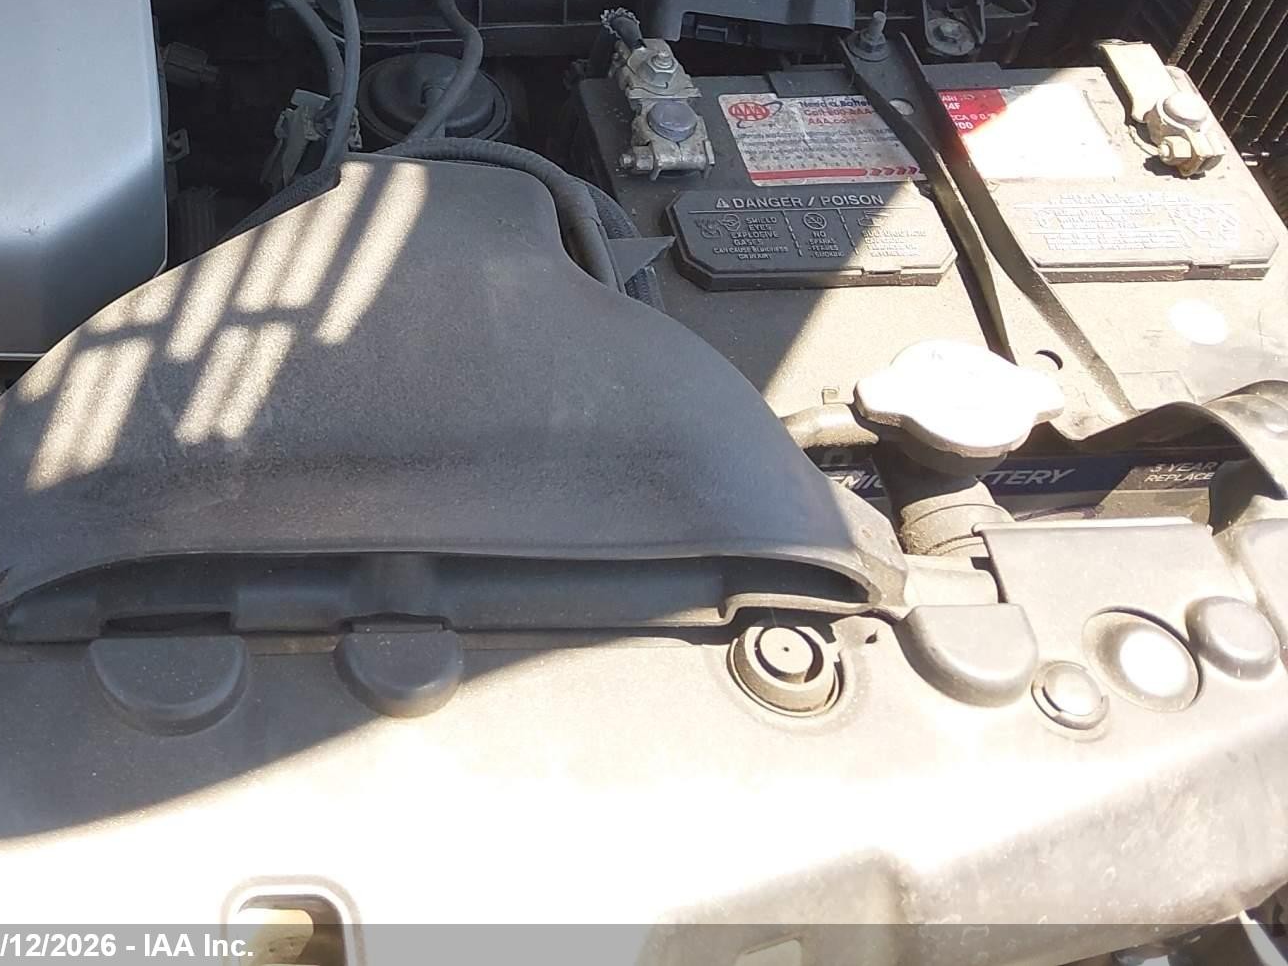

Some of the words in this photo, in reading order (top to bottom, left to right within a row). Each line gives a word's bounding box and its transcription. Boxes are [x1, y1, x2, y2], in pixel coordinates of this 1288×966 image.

[798, 100, 827, 108] Need
[729, 103, 769, 120] AAA
[732, 196, 804, 209] DANGER
[807, 196, 815, 207] /
[820, 194, 885, 206] POISON
[812, 230, 827, 238] NO
[1167, 461, 1219, 472] YEAR
[1143, 472, 1216, 482] REPLACE
